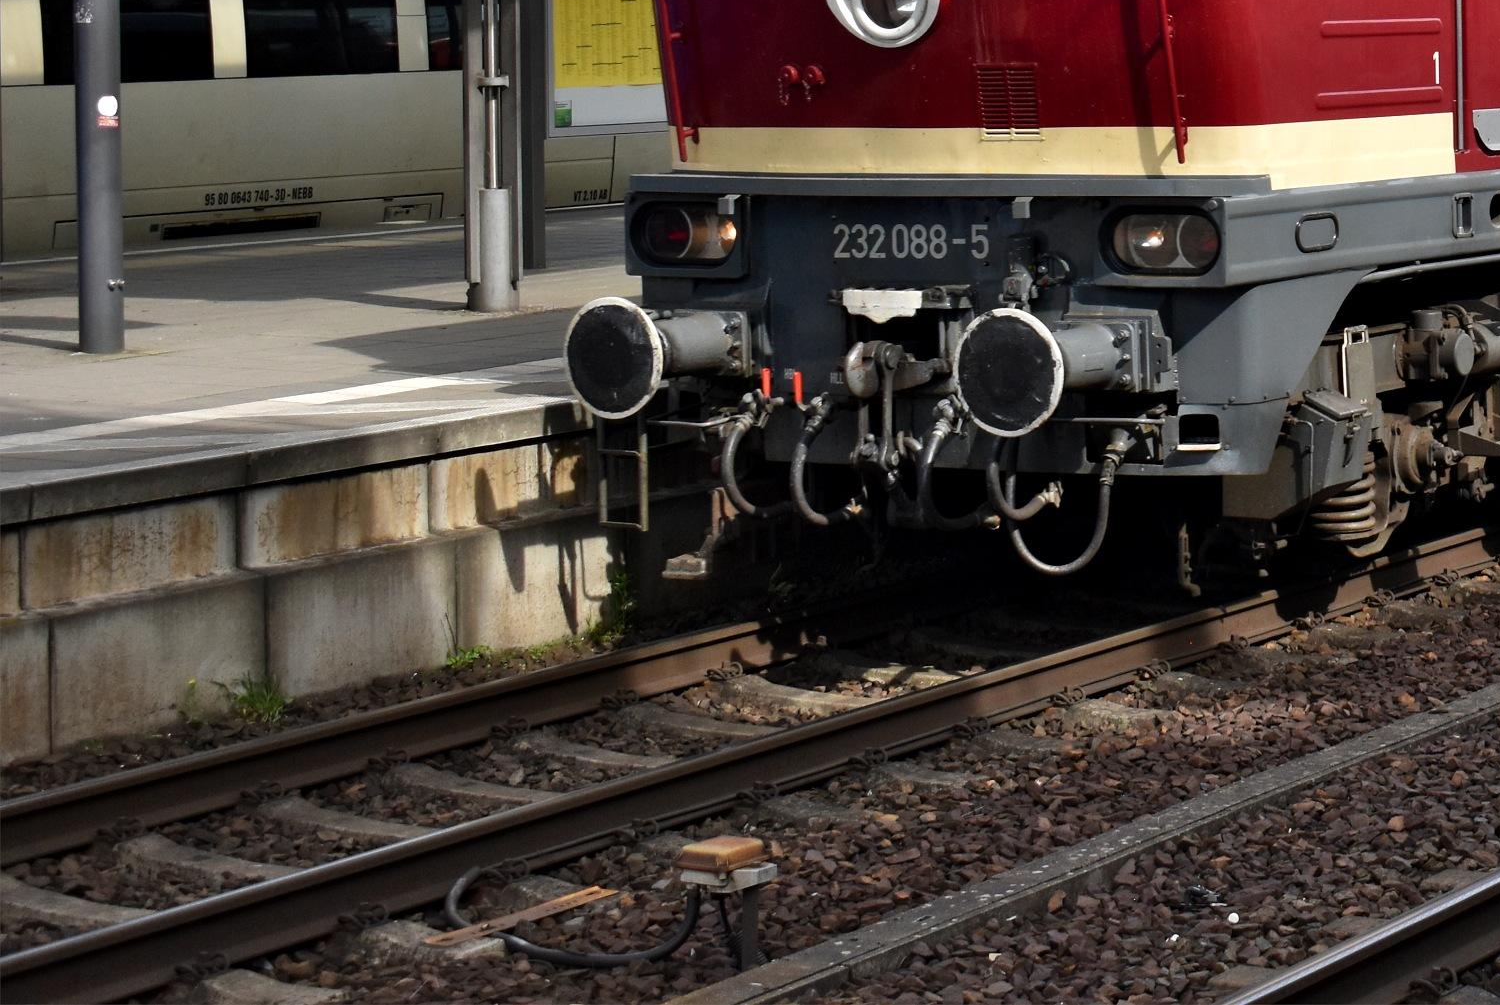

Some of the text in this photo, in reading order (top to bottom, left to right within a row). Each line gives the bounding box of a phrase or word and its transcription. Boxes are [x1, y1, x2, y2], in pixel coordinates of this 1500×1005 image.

[1433, 51, 1440, 84] 1
[205, 193, 215, 206] 95
[218, 192, 228, 205] 80
[231, 190, 252, 204] 0643
[833, 223, 989, 259] 232 088-5
